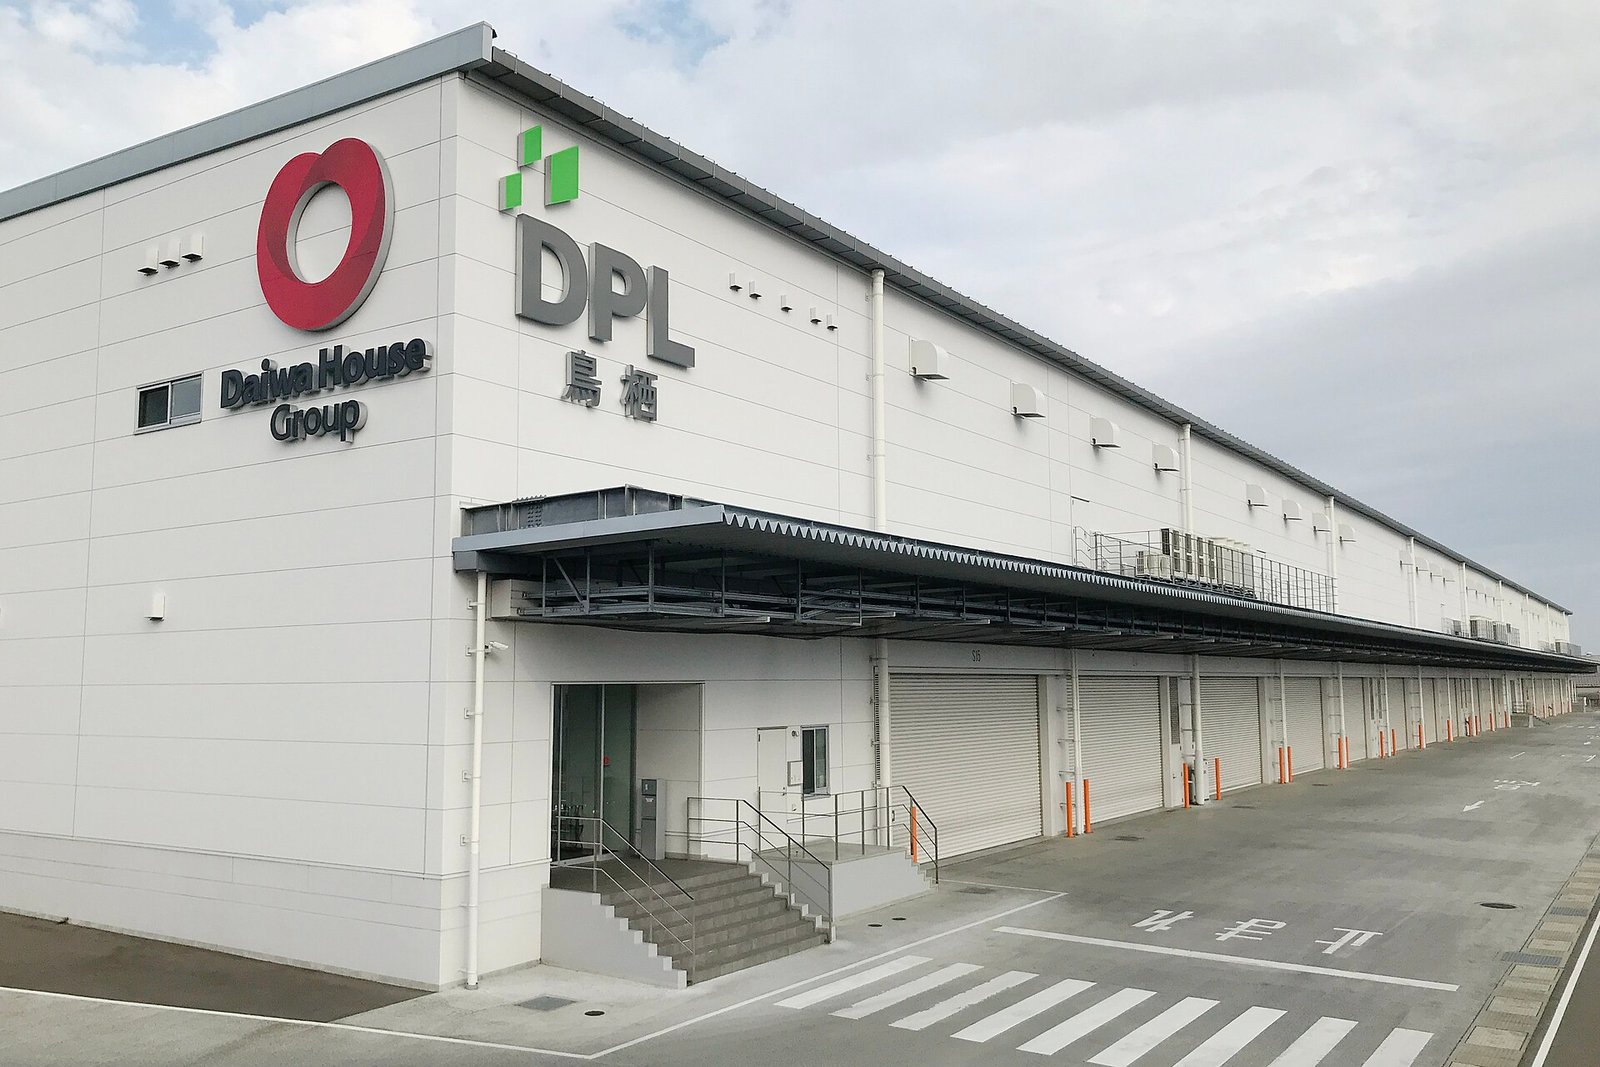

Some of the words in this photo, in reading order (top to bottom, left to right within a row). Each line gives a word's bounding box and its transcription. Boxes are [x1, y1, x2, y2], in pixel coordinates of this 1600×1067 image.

[515, 213, 695, 369] DPL
[220, 358, 314, 410] Daiwa
[318, 337, 432, 390] House
[562, 350, 659, 423] 鳥栖
[270, 399, 367, 443] Group
[1132, 908, 1384, 955] 止まれ
